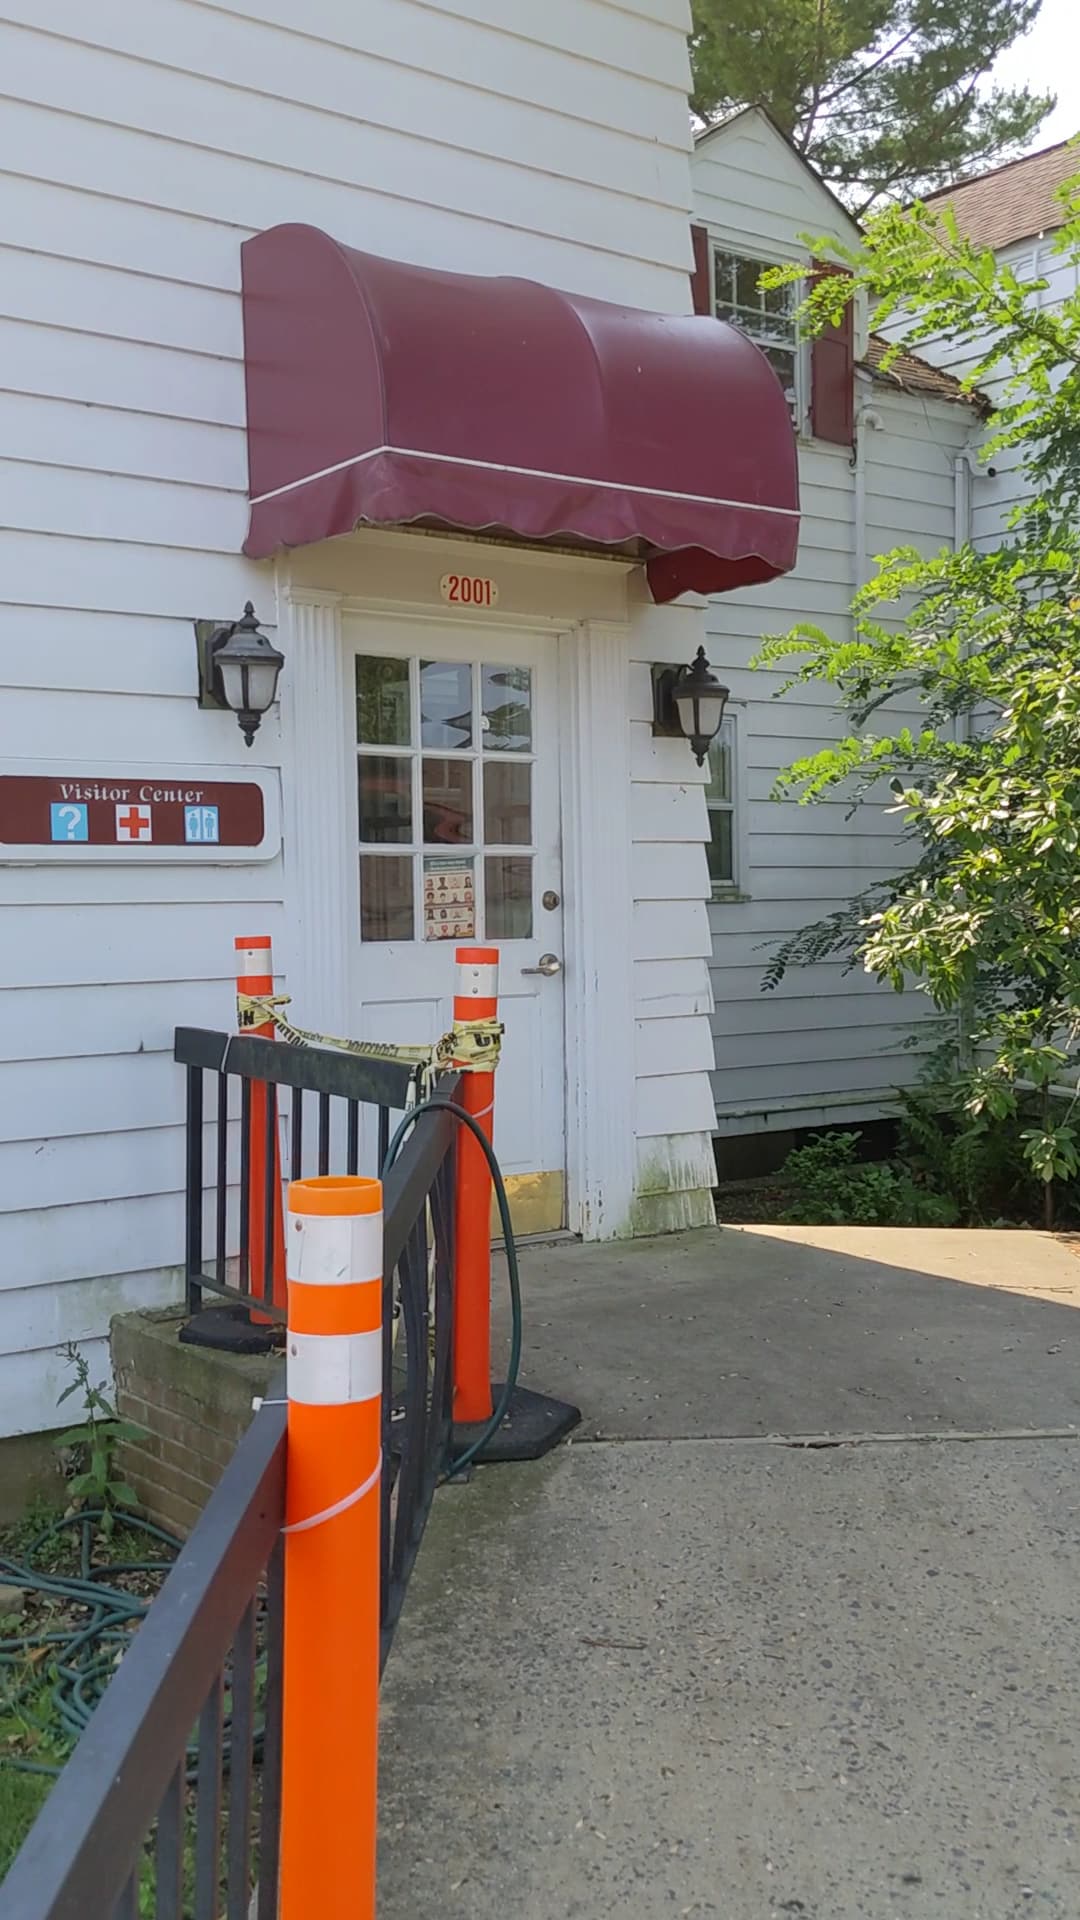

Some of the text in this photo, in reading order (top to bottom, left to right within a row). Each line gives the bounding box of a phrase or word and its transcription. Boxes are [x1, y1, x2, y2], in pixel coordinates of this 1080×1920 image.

[448, 575, 490, 606] 2001
[60, 783, 204, 803] Visitor Center
